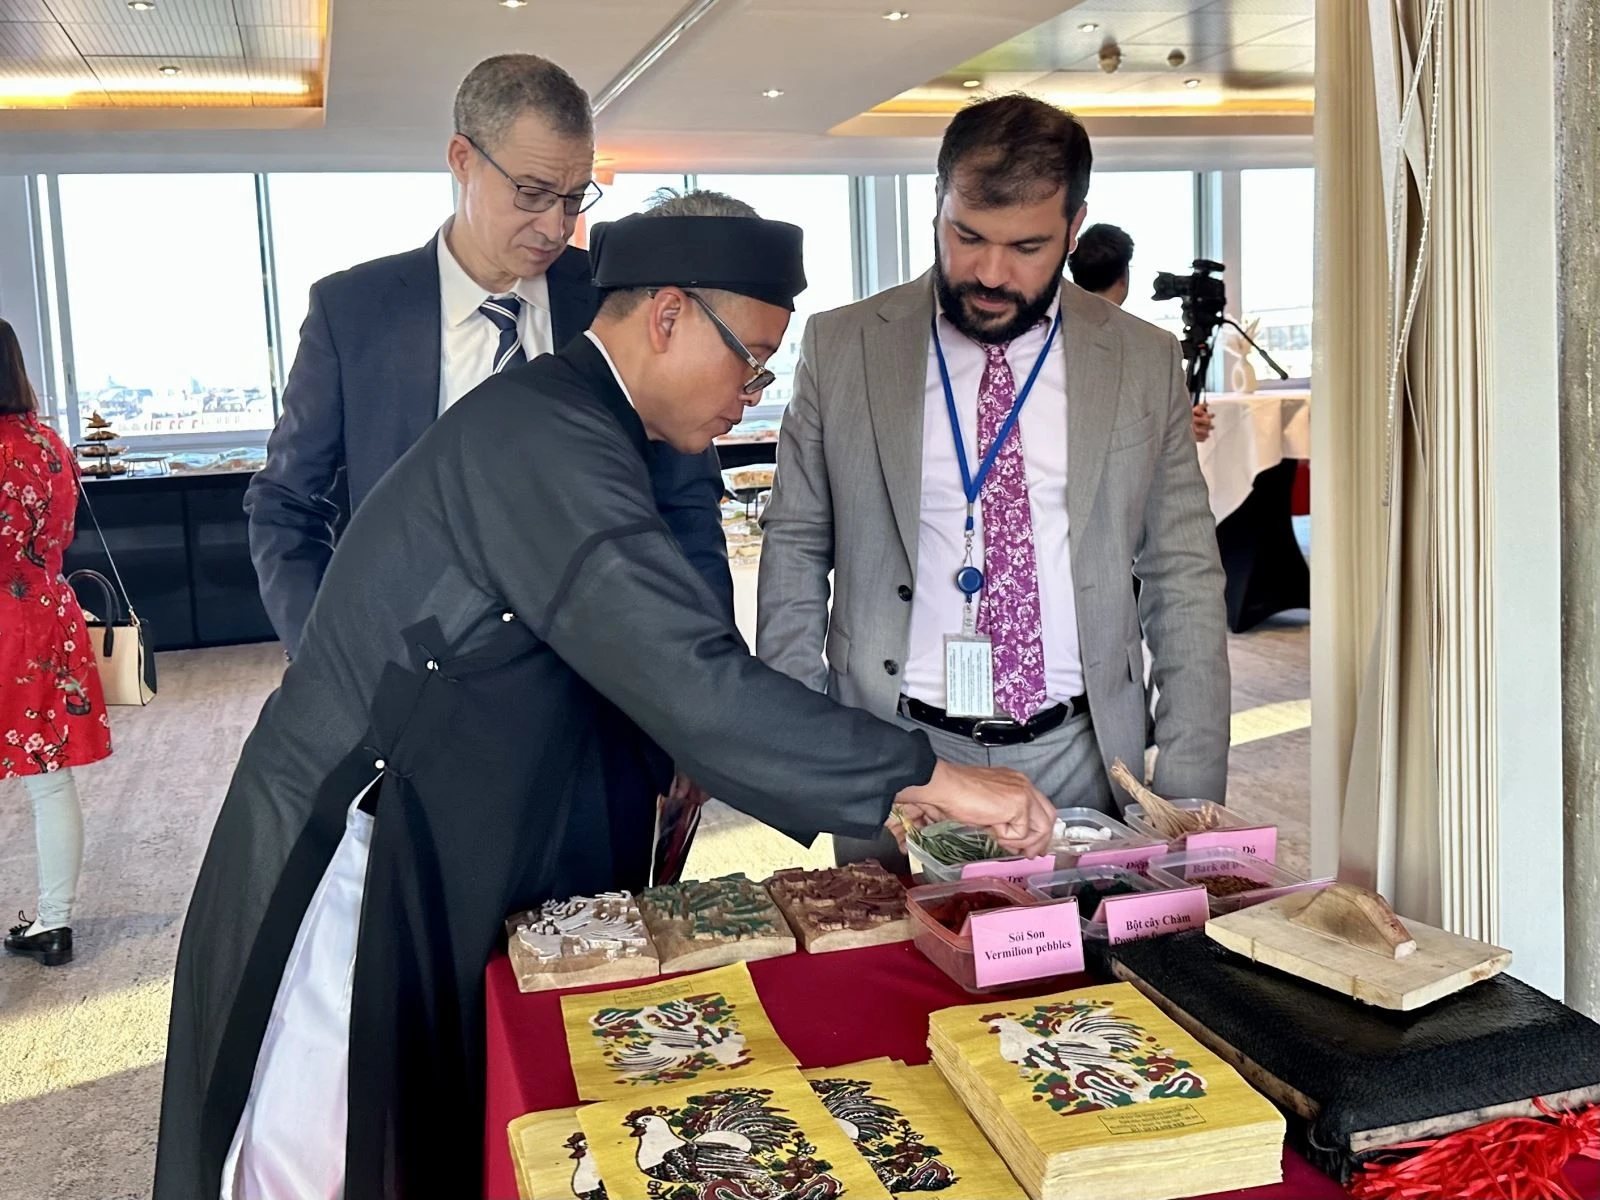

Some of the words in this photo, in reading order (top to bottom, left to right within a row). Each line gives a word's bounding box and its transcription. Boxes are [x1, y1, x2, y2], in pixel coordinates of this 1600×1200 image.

[1193, 863, 1218, 873] Bark
[1126, 919, 1142, 932] Bột
[1026, 930, 1045, 940] Son
[985, 946, 1033, 960] Vermilion
[1036, 939, 1072, 955] pebbles
